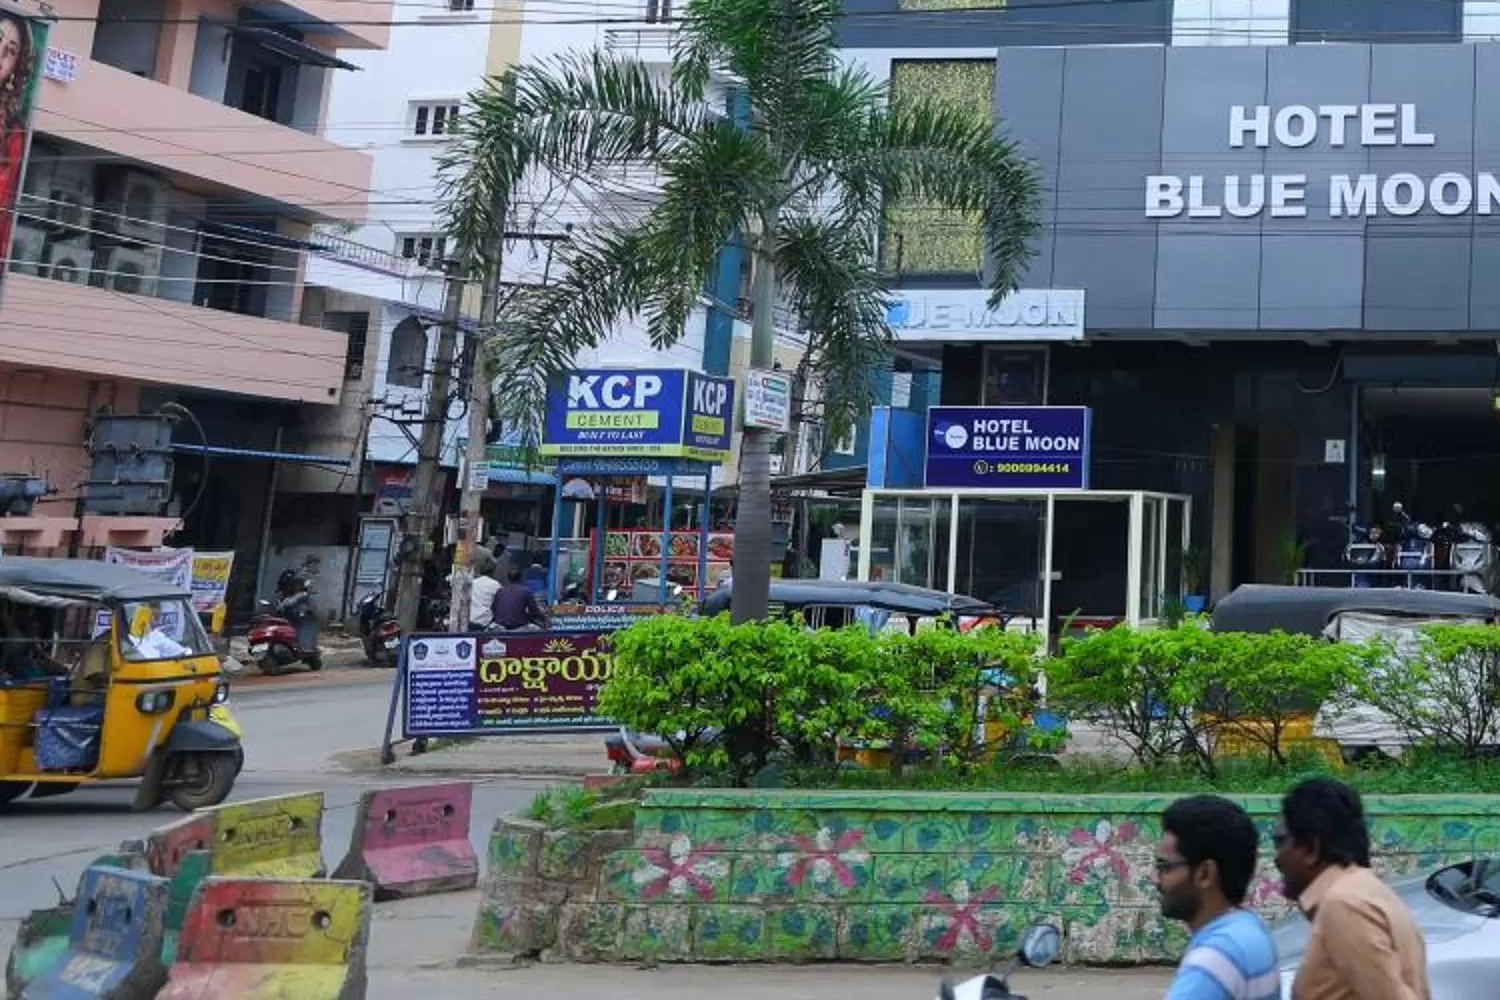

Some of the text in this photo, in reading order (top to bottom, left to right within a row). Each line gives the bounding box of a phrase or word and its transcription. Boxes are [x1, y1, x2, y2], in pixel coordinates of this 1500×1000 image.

[1228, 103, 1436, 148] HOTEL
[1144, 174, 1307, 218] BLUE
[567, 375, 663, 409] KCP
[693, 379, 727, 415] KCP
[577, 414, 645, 427] CEMENT
[973, 419, 1033, 433] HOTEL
[973, 436, 1080, 451] BLUE MOON
[479, 647, 613, 693] దాక్షాయ
